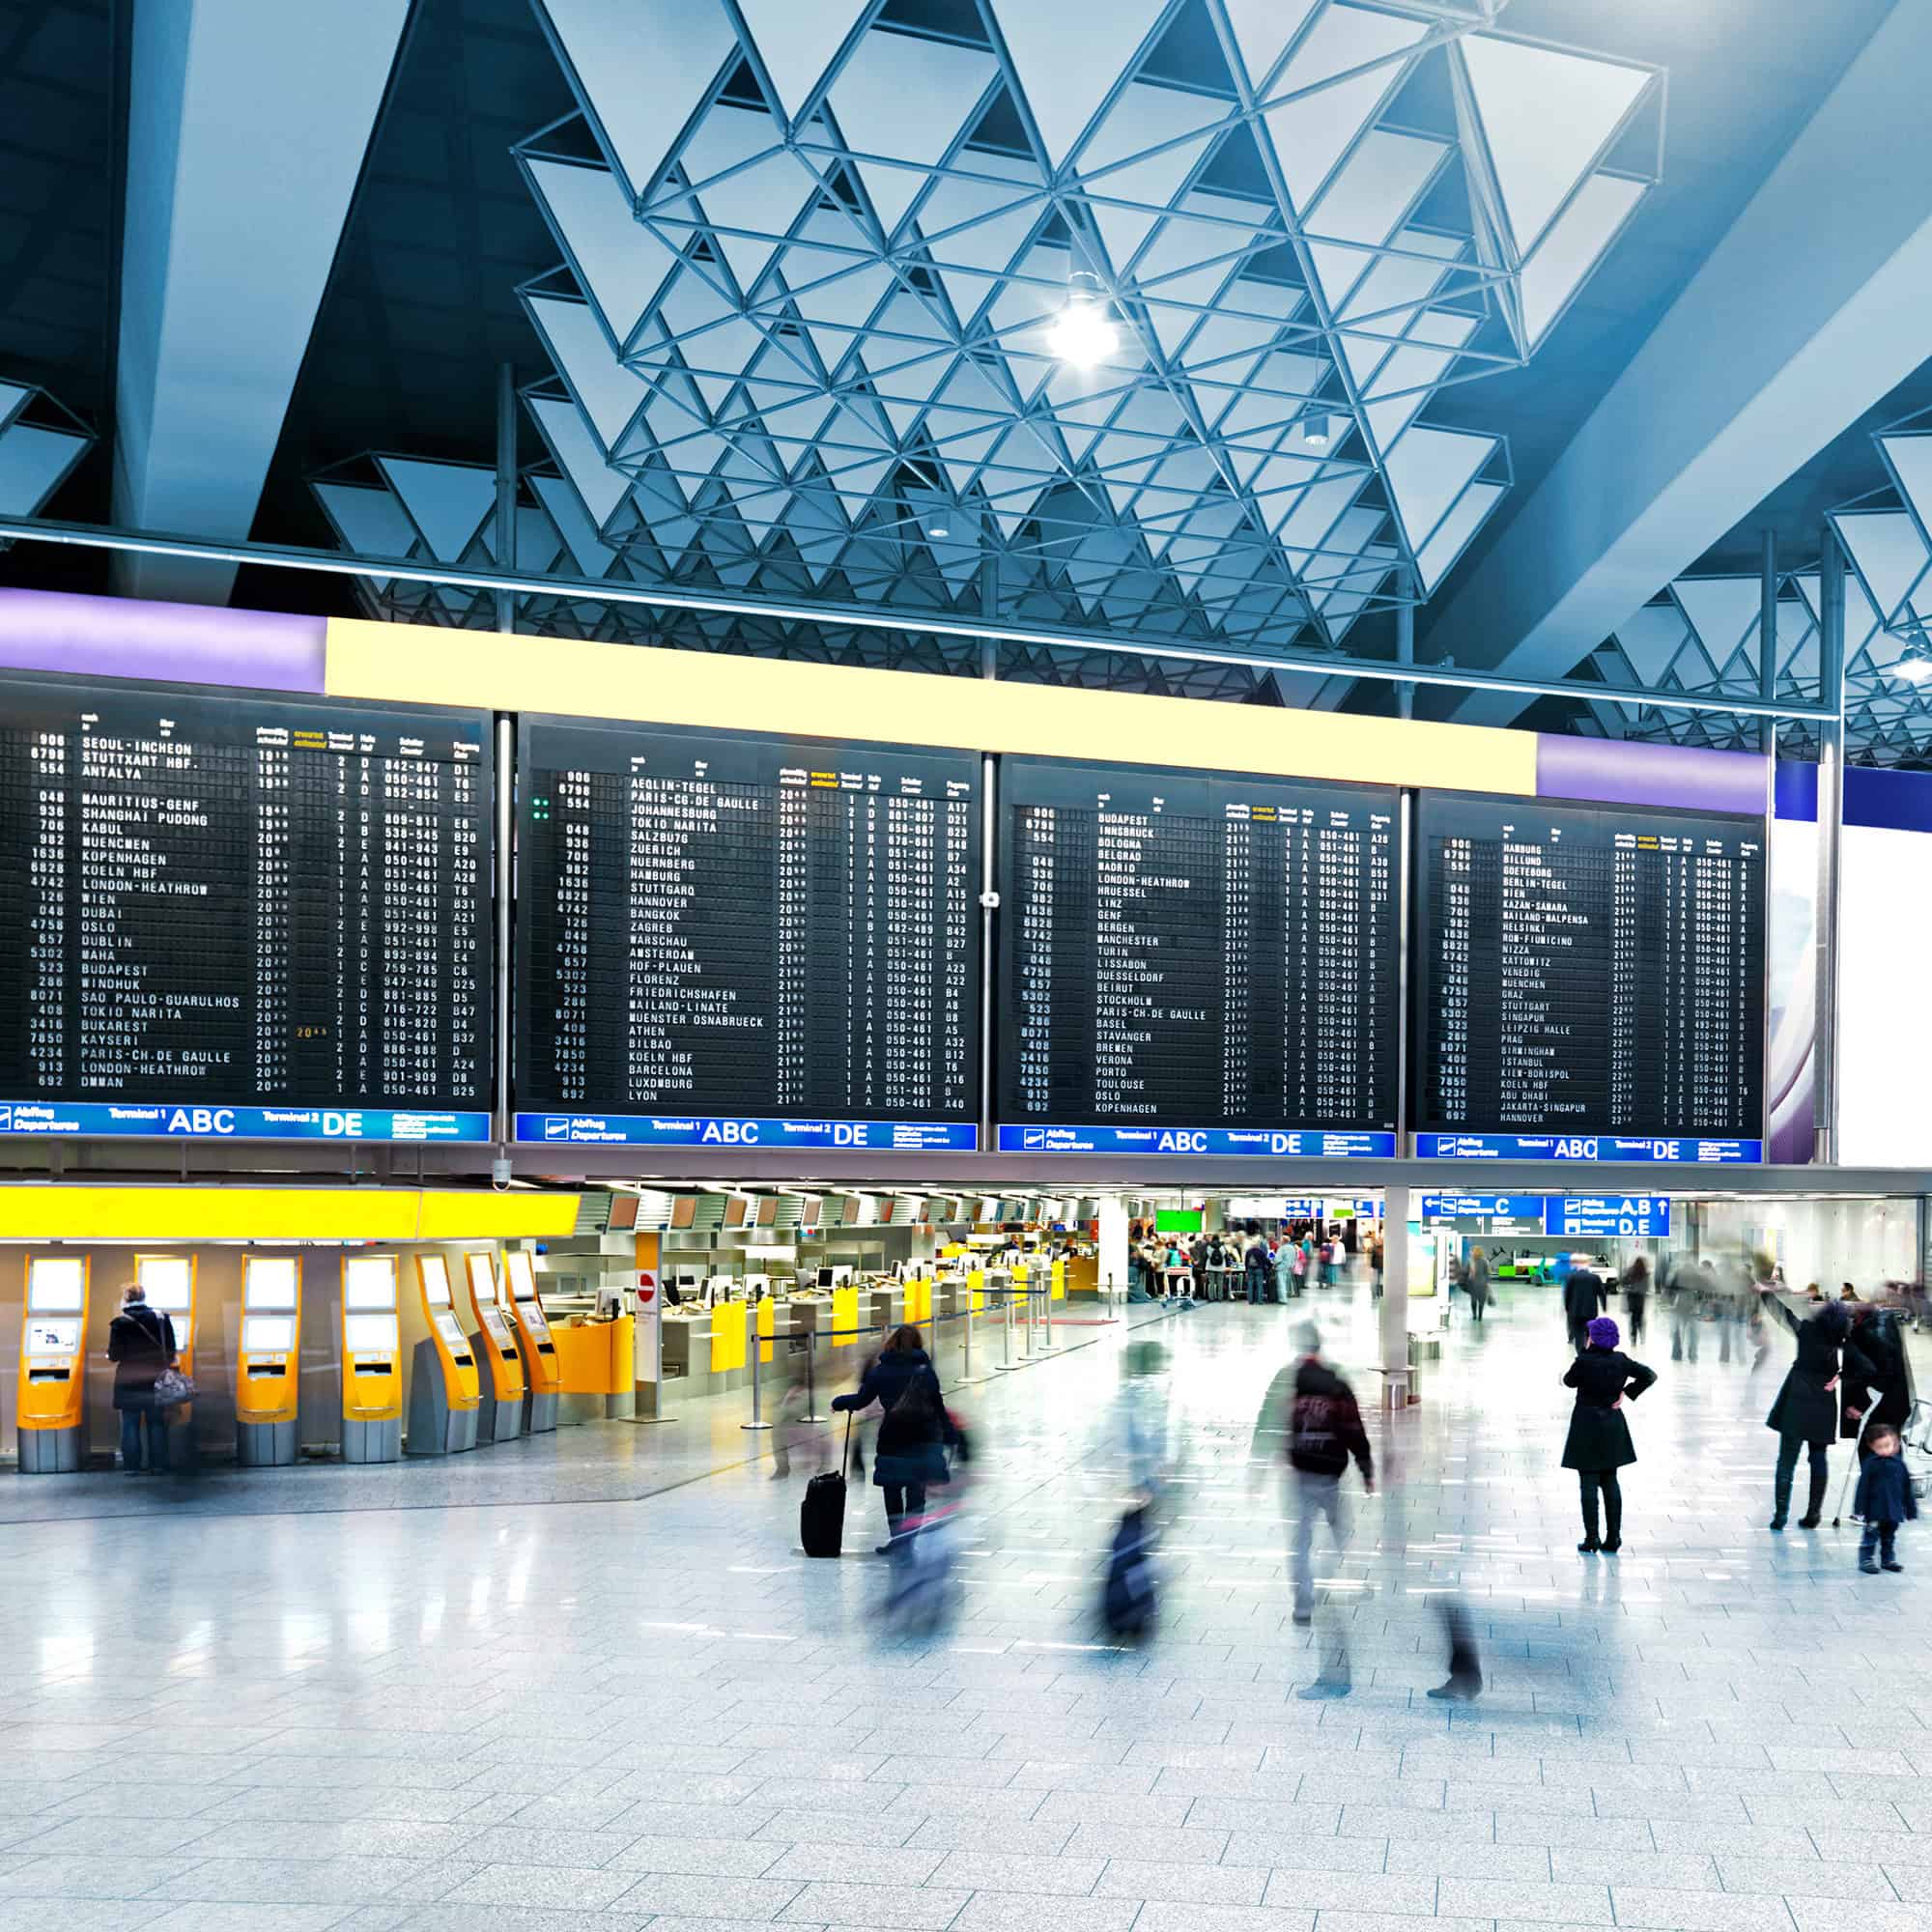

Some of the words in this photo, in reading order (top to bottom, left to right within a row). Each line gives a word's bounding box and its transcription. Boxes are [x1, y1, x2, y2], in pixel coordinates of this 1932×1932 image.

[83, 737, 190, 755] SEOUL-INCHEON
[40, 761, 64, 775] 554
[82, 765, 140, 780] ANTALYA
[82, 794, 199, 811] MAURITIUS-GENF
[82, 808, 147, 822] SHANGHAI
[157, 812, 207, 826] PUDONG
[82, 822, 124, 835] KABUL
[82, 850, 165, 866] KOPENHAGEN
[82, 865, 124, 877] KOELN
[132, 867, 156, 879] HBF
[82, 879, 207, 895] LONDON-HEATHROW
[82, 893, 115, 905] WIEN
[82, 907, 121, 919] DUBAI
[82, 922, 115, 933] OSLO
[82, 936, 131, 948] DUBLIN
[81, 964, 148, 977] BUDAPEST
[81, 979, 139, 990] WINDHUK
[81, 992, 106, 1004] SAO
[115, 993, 240, 1008] PAULO-GUARULHOS
[81, 1007, 123, 1018] TOKIO
[131, 1009, 182, 1020] NARITA
[81, 1021, 148, 1033] BUKAREST
[81, 1035, 137, 1046] KAYSERI
[81, 1049, 173, 1062] PARIS-CH.DE
[182, 1052, 231, 1063] GAULLE
[81, 1064, 206, 1076] LONDON-HEATHROW
[109, 1108, 158, 1120] Terminal
[160, 1109, 166, 1120] 1
[263, 1111, 310, 1122] Terminal
[168, 1109, 234, 1134] ABC
[323, 1113, 362, 1136] DE
[651, 1121, 694, 1130] Terminal
[696, 1121, 700, 1130] 1
[782, 1122, 822, 1132] Terminal
[824, 1123, 831, 1133] 2
[701, 1122, 758, 1144] ABC
[835, 1124, 867, 1145] DE
[1158, 1131, 1207, 1151] ABC
[1271, 1134, 1301, 1153] DE
[1554, 1140, 1596, 1158] ABC
[1653, 1141, 1679, 1159] DE
[1495, 1198, 1509, 1214] C
[1620, 1199, 1651, 1215] A,B
[1619, 1219, 1650, 1236] D,E
